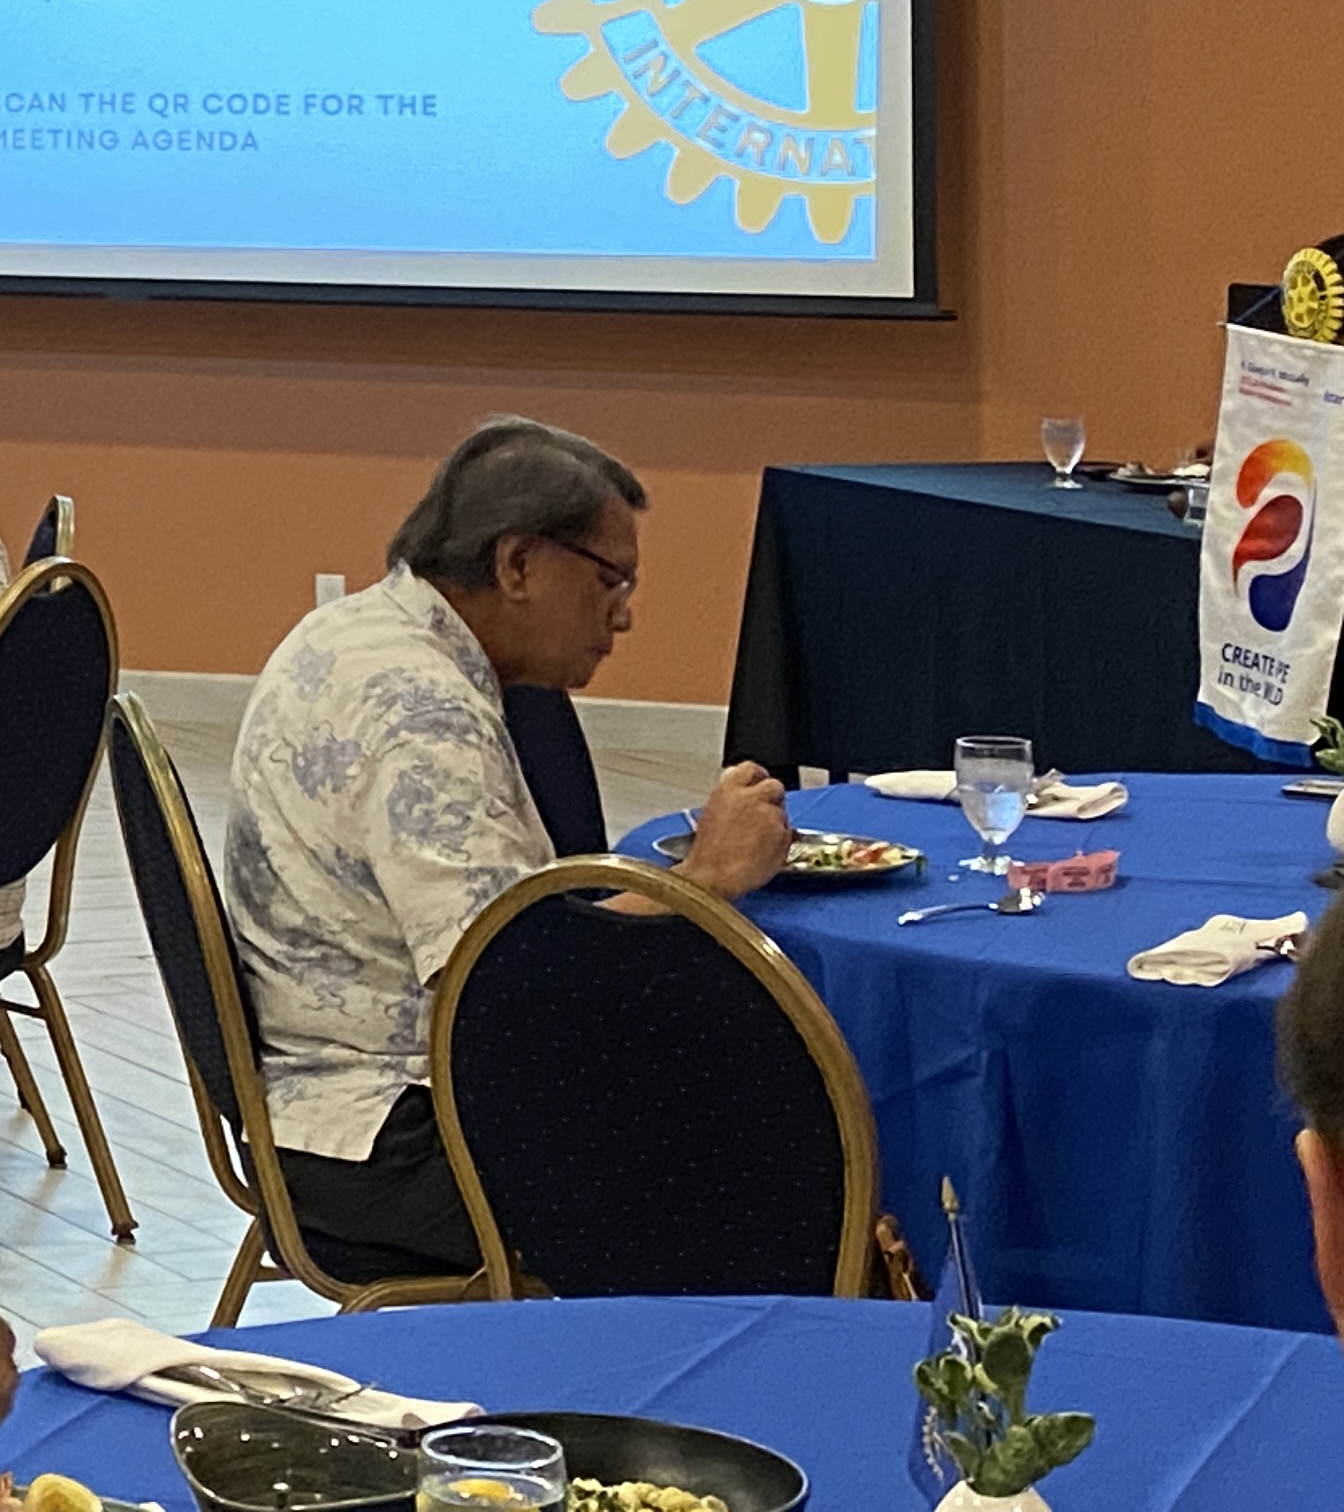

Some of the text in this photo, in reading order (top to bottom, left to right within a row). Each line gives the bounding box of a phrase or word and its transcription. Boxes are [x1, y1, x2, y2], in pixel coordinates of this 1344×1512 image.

[79, 92, 136, 115] THE
[147, 91, 190, 119] QR
[201, 92, 292, 117] CODE
[303, 92, 364, 117] FOR
[374, 93, 438, 118] THE
[130, 128, 260, 153] AGENDA
[1221, 642, 1275, 678] CREATE
[1217, 664, 1234, 688] in
